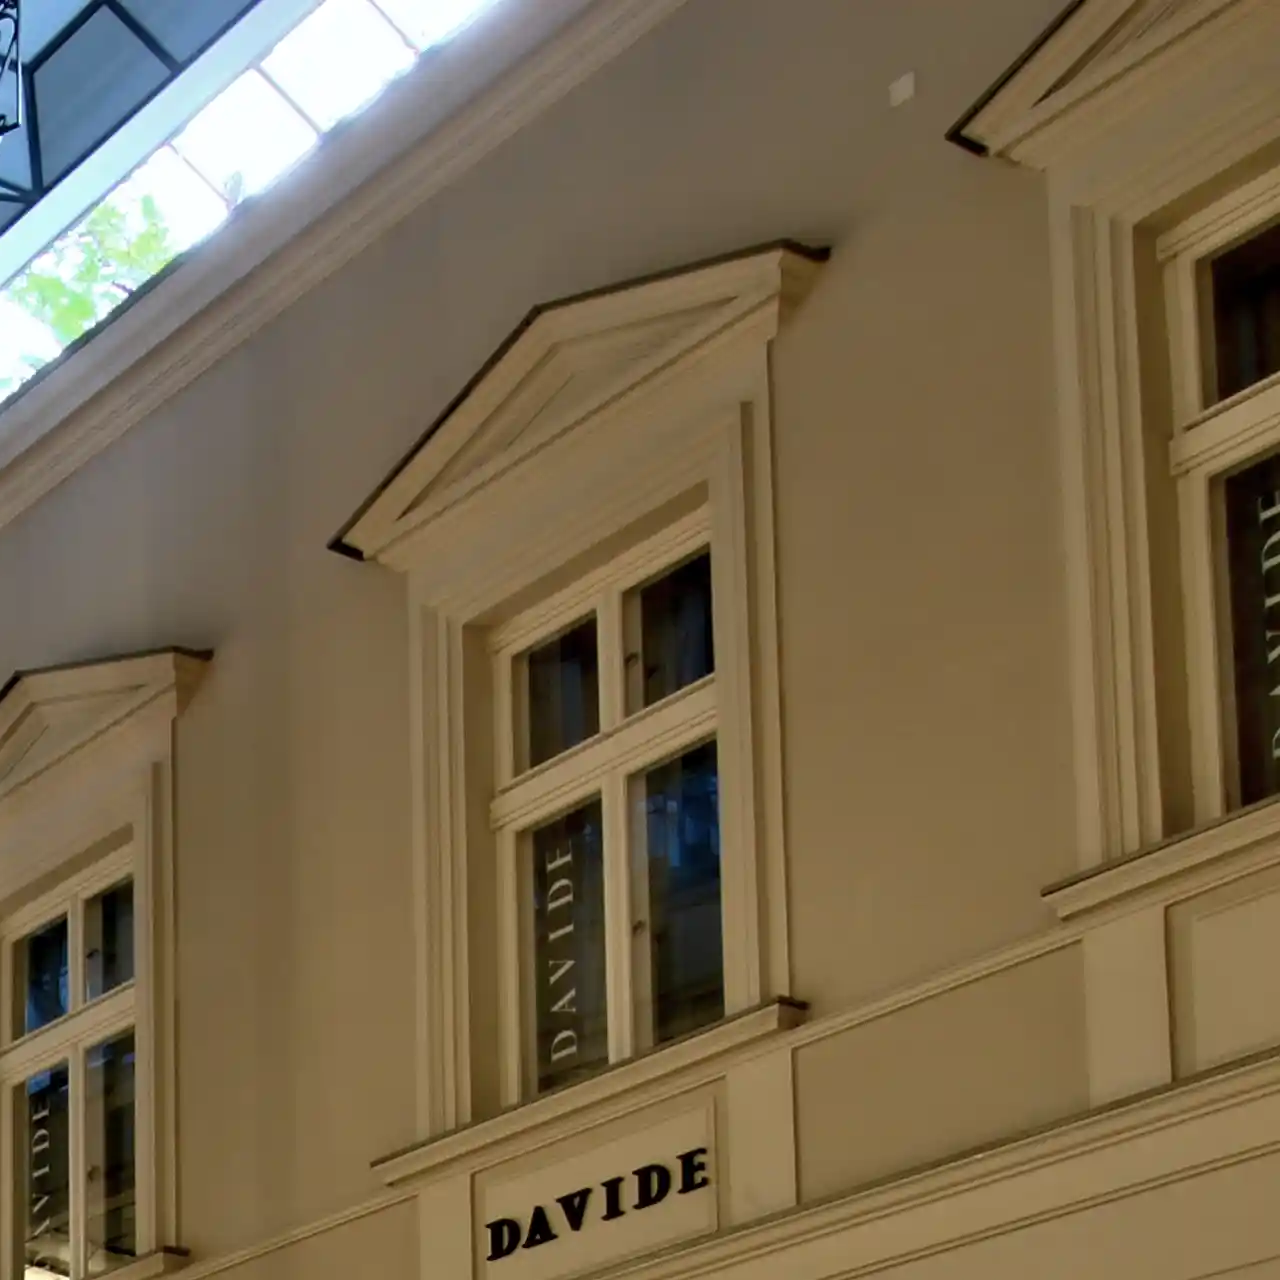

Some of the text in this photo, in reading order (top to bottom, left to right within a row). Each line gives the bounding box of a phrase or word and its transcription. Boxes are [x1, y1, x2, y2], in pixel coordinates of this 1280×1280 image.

[545, 838, 578, 1064] DAVIDE
[30, 1098, 52, 1264] AVIDE
[485, 1147, 710, 1262] DAVIDE
